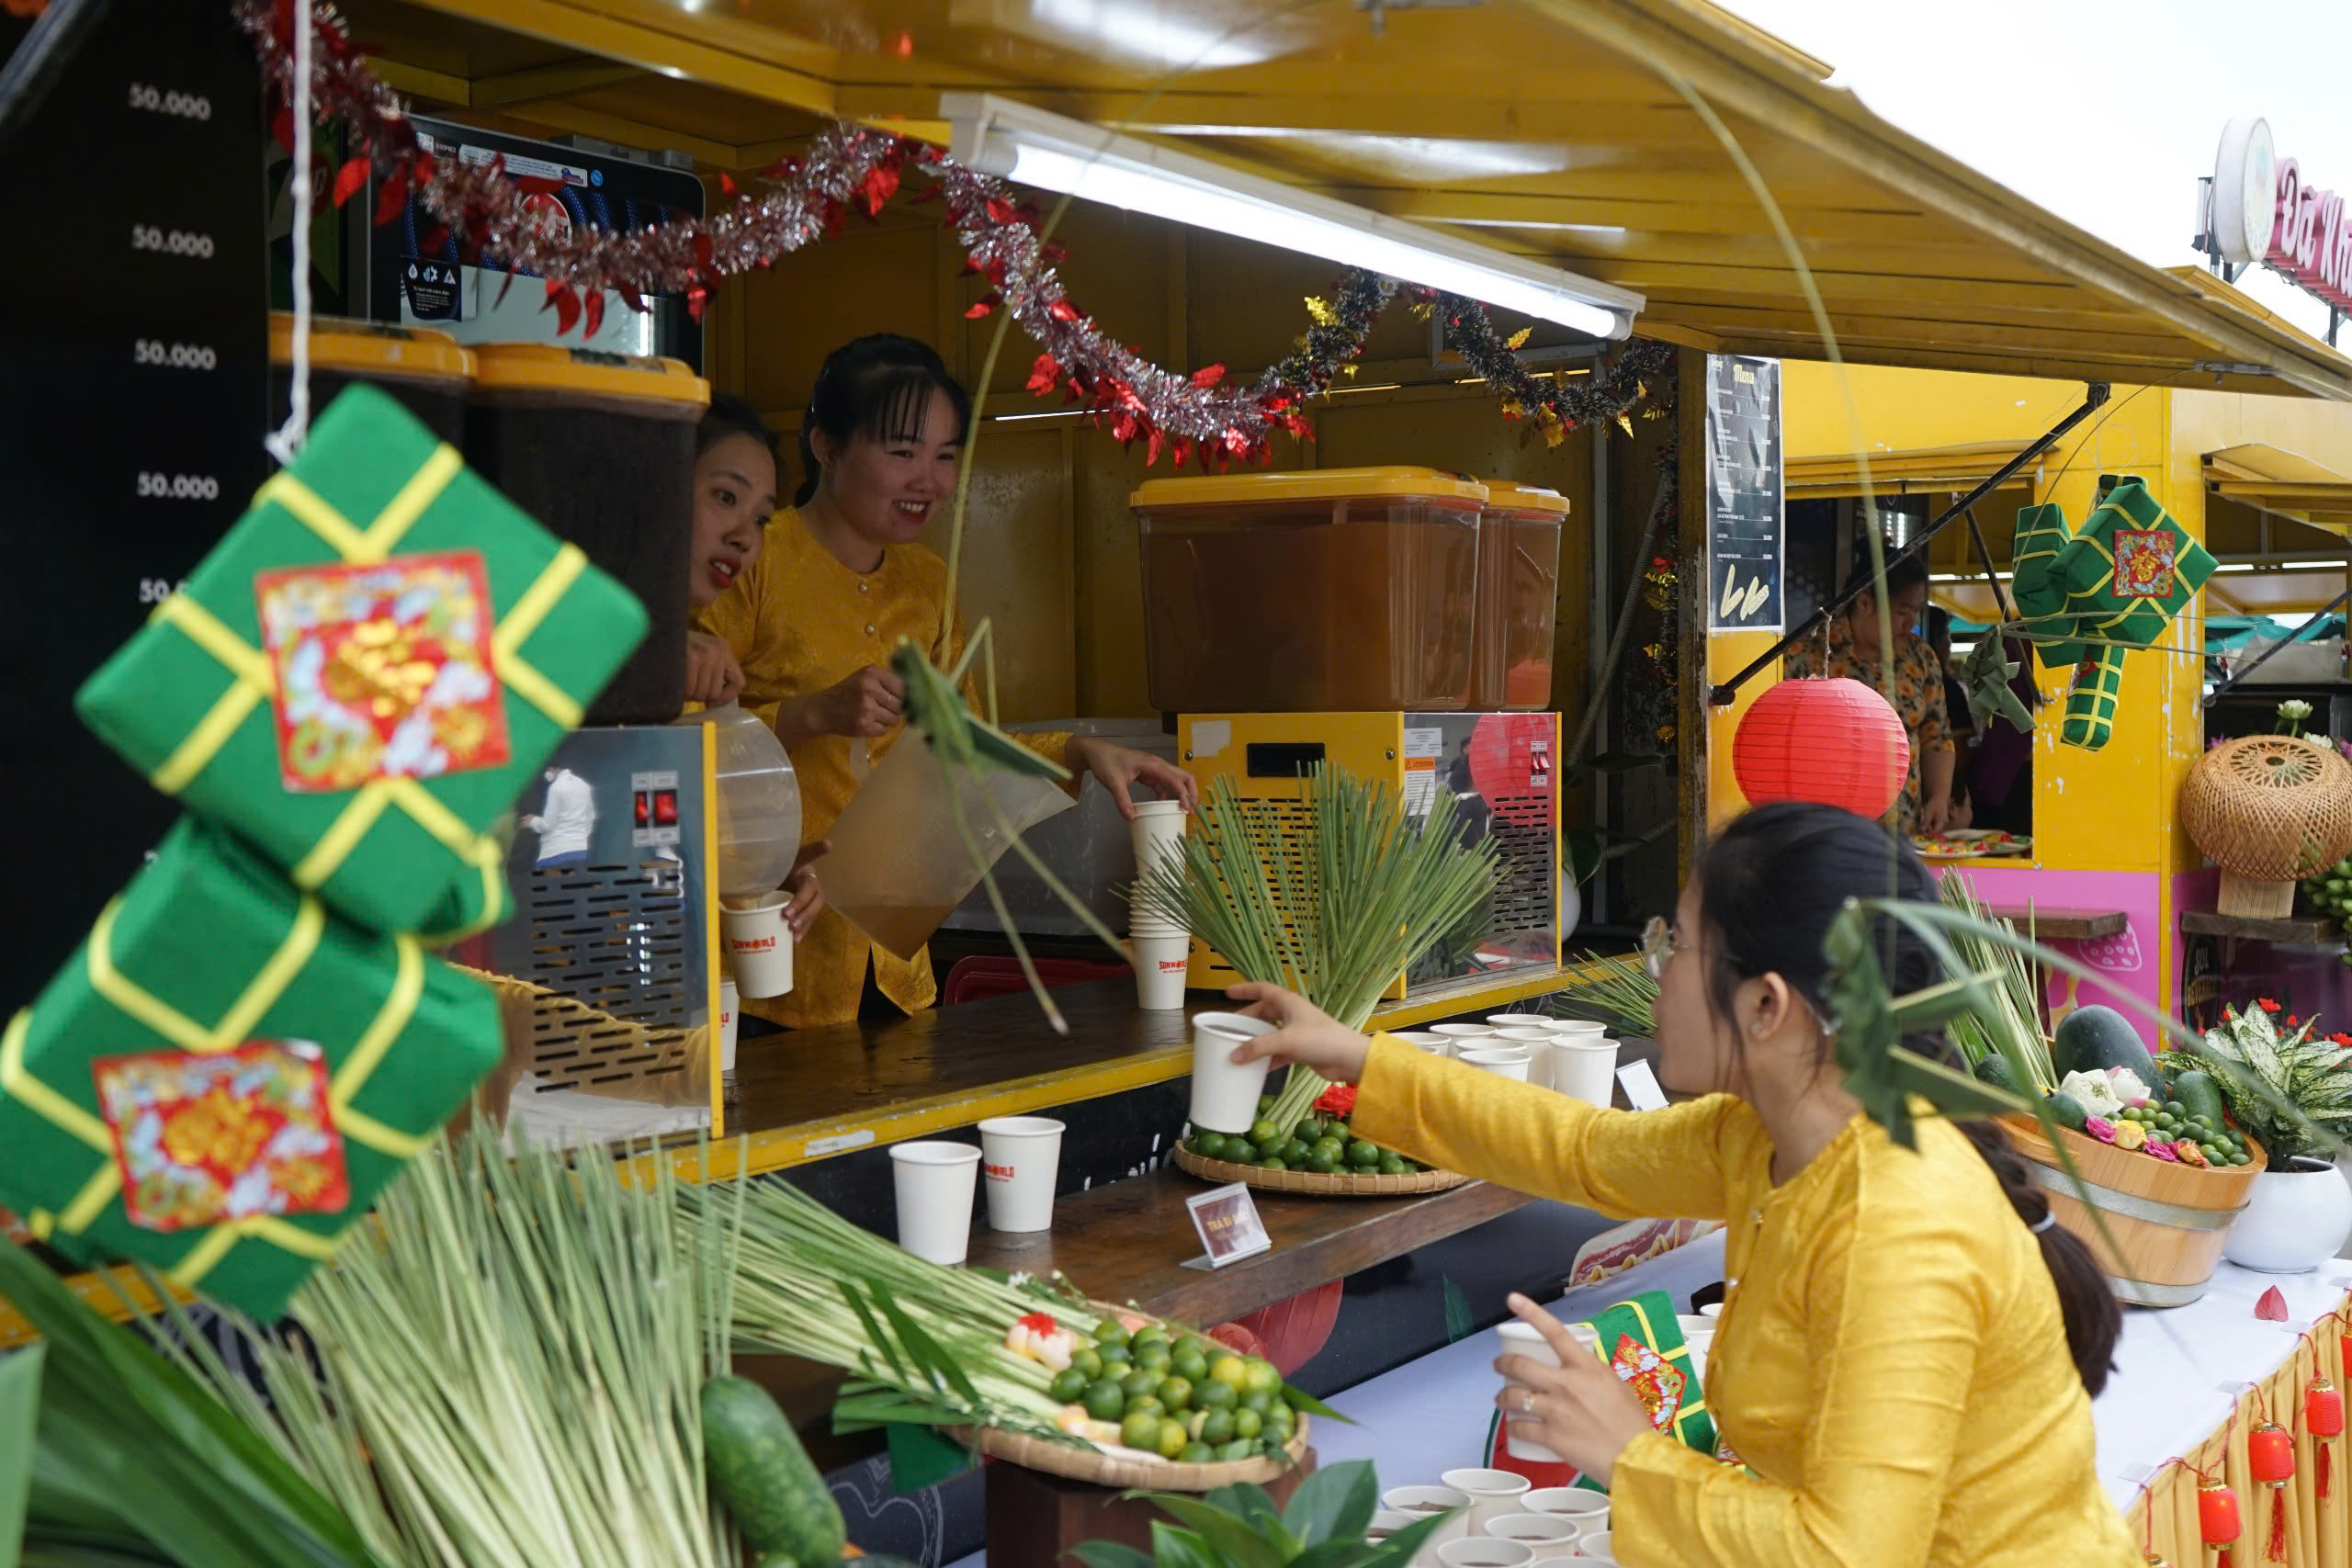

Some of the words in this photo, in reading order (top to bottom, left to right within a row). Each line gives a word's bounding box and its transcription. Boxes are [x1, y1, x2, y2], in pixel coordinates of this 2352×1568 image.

[130, 83, 212, 120] 50.000
[132, 224, 214, 259] 50.000
[135, 339, 217, 370] 50.000
[1734, 364, 1755, 385] Menu
[138, 472, 219, 501] 50.000
